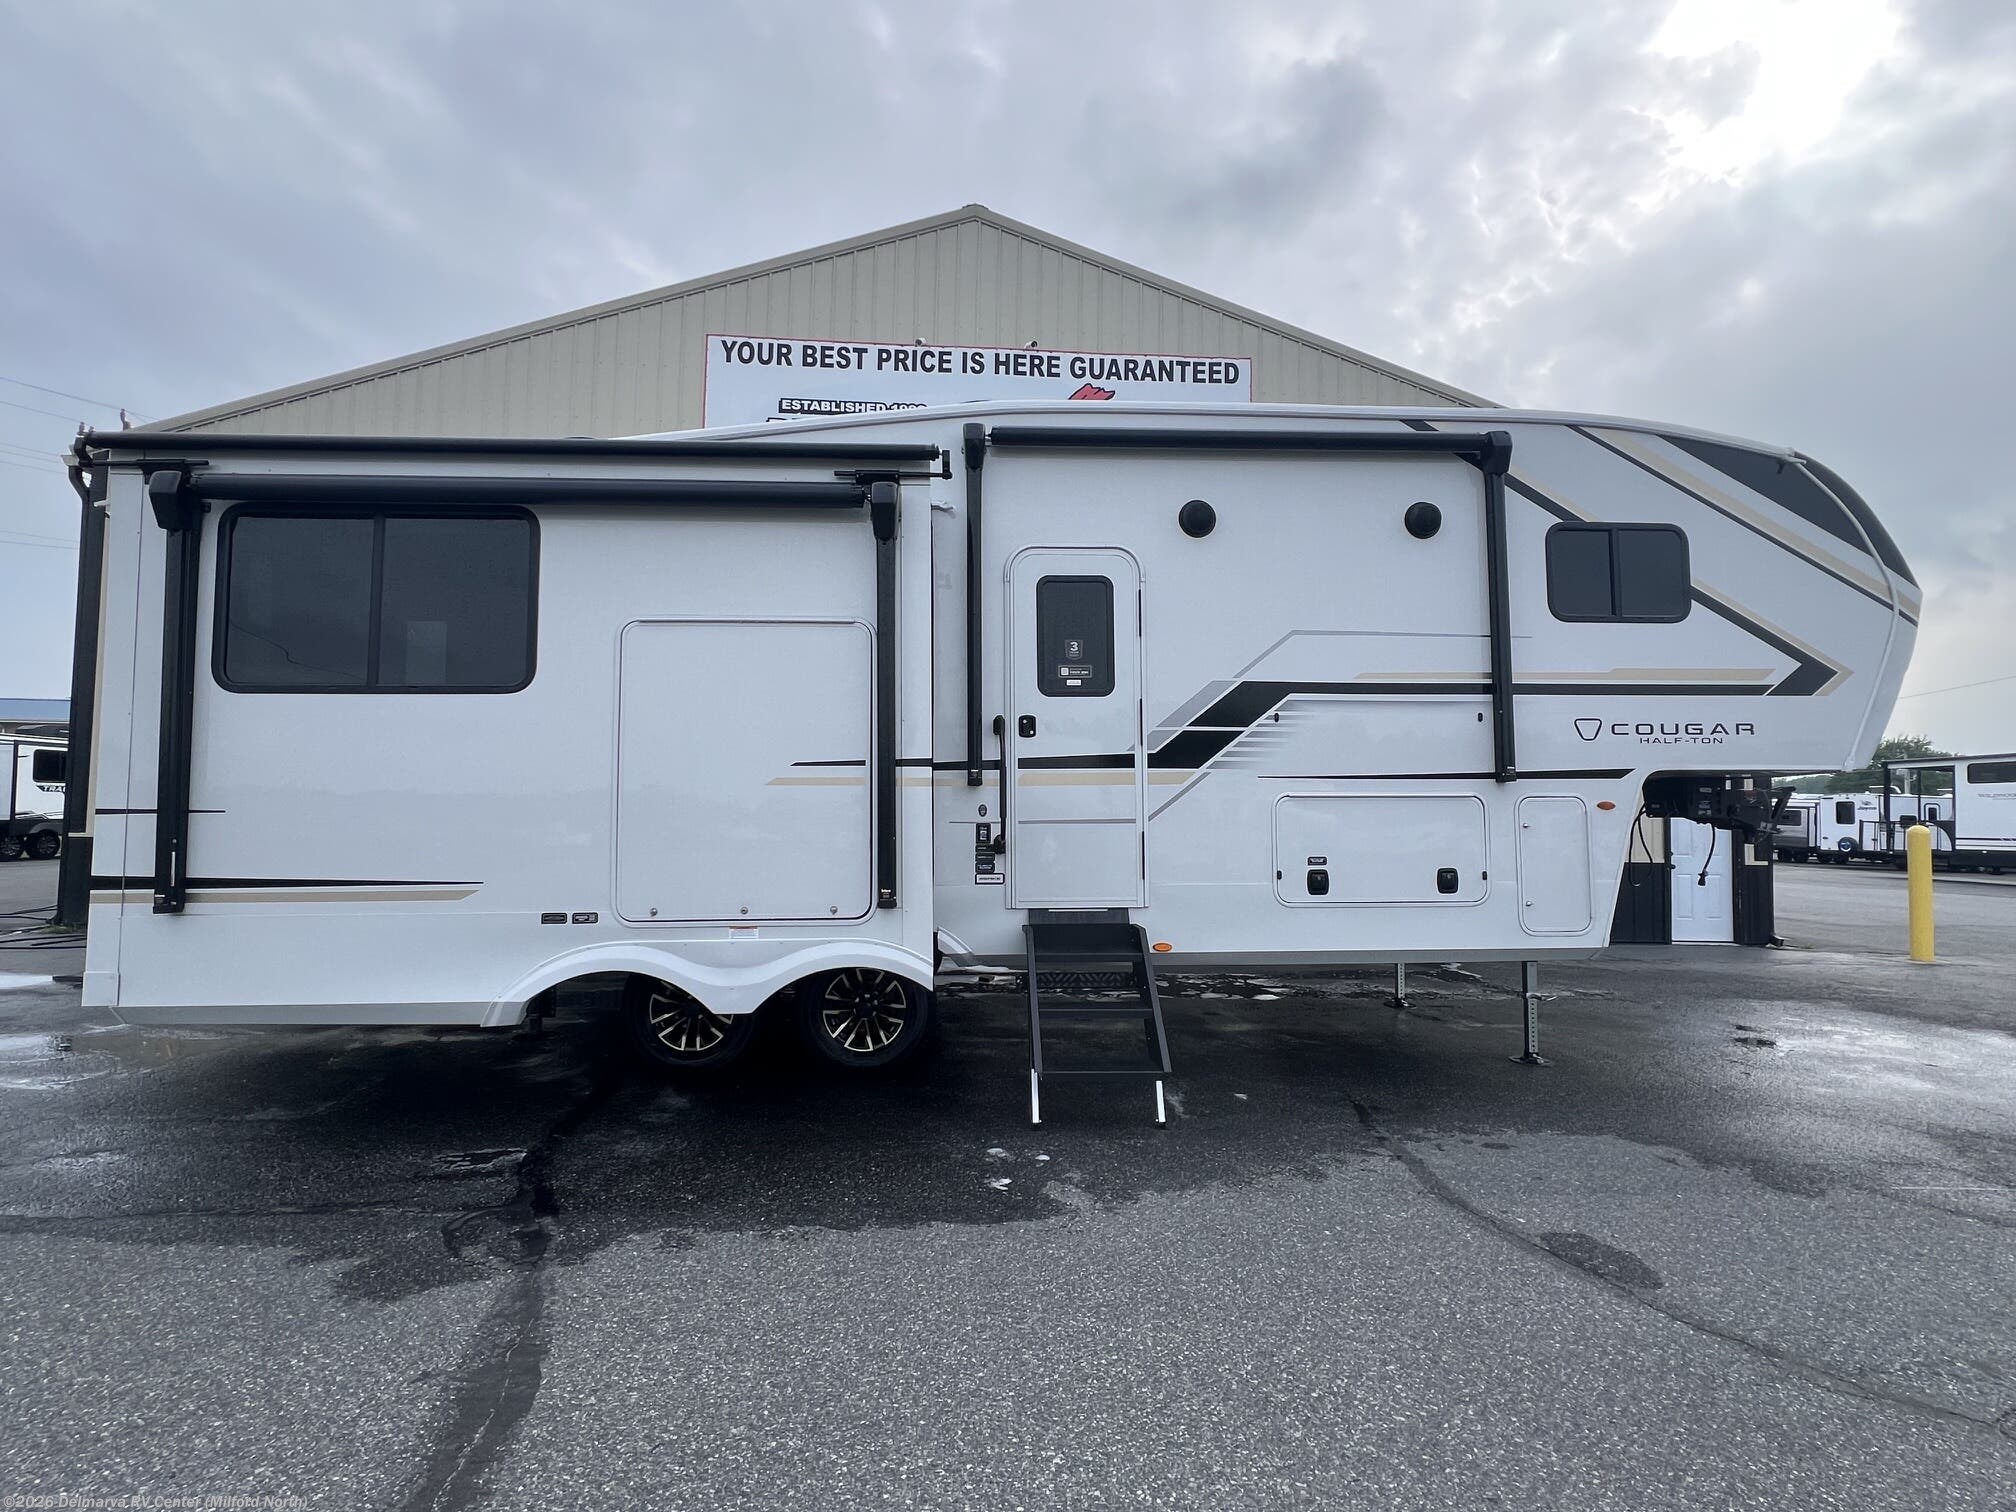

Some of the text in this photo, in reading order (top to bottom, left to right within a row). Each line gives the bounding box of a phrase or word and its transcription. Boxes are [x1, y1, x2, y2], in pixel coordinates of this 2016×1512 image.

[721, 339, 1240, 384] YOUR BEST PRICE IS HERE GUARANTEED
[781, 399, 887, 412] ESTABLISHED
[1070, 641, 1079, 651] 3
[1611, 722, 1756, 736] COUGAR
[1639, 737, 1724, 745] HALF-TON
